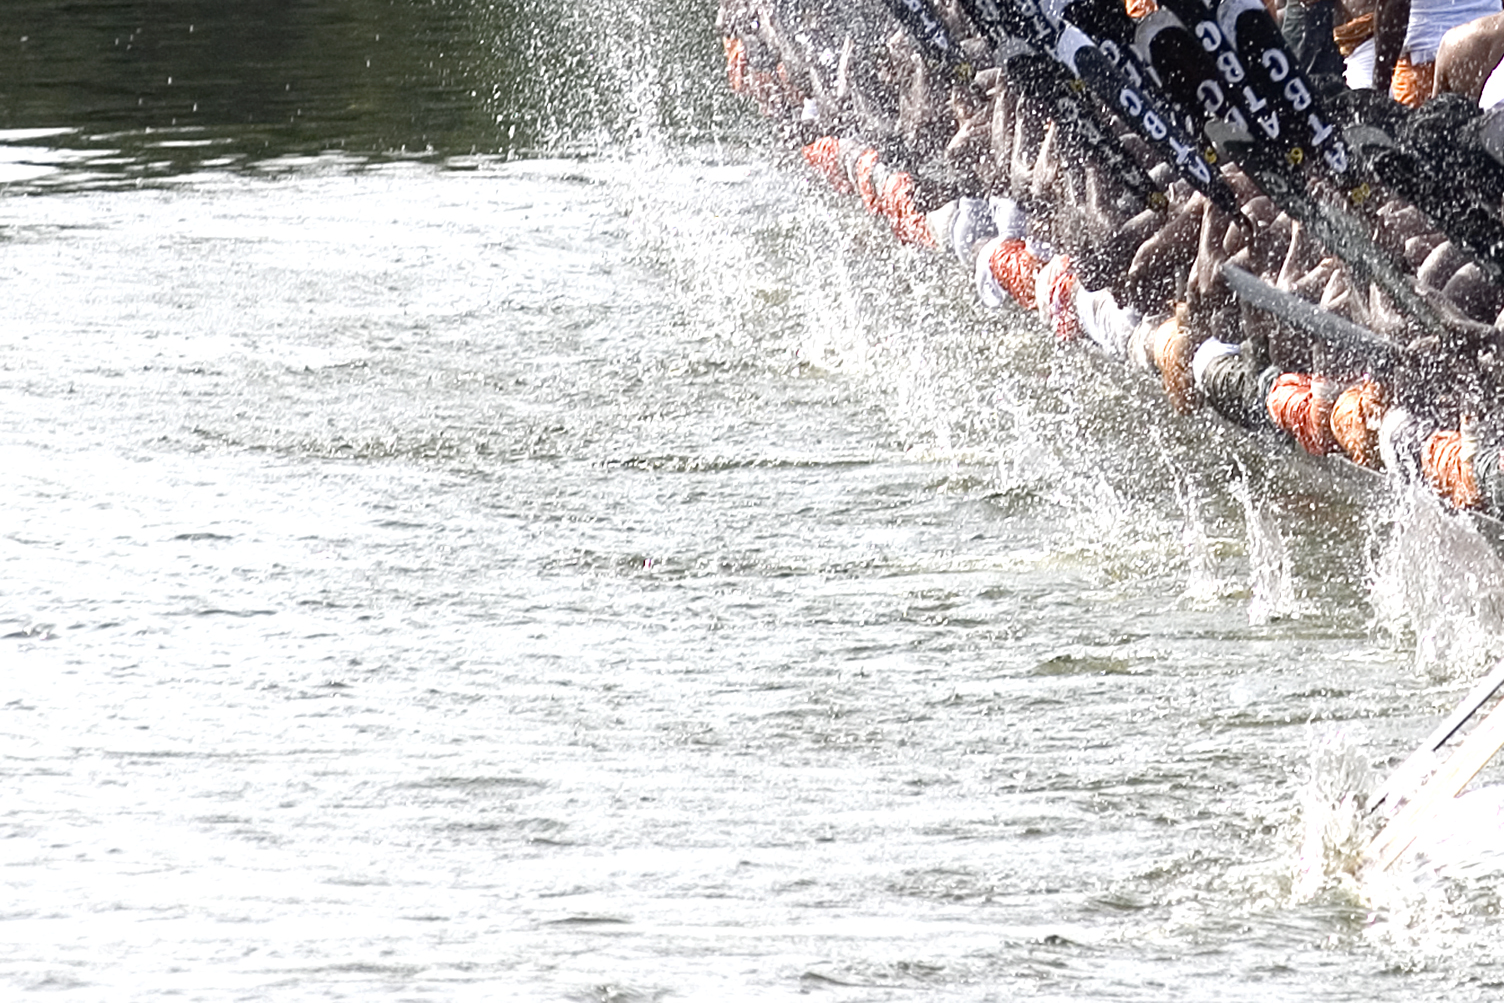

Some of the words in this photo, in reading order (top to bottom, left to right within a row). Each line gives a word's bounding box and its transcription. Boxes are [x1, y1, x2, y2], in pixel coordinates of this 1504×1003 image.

[1119, 88, 1212, 184] ATBC
[1195, 20, 1281, 140] ATBC
[1262, 48, 1349, 174] ATBC
